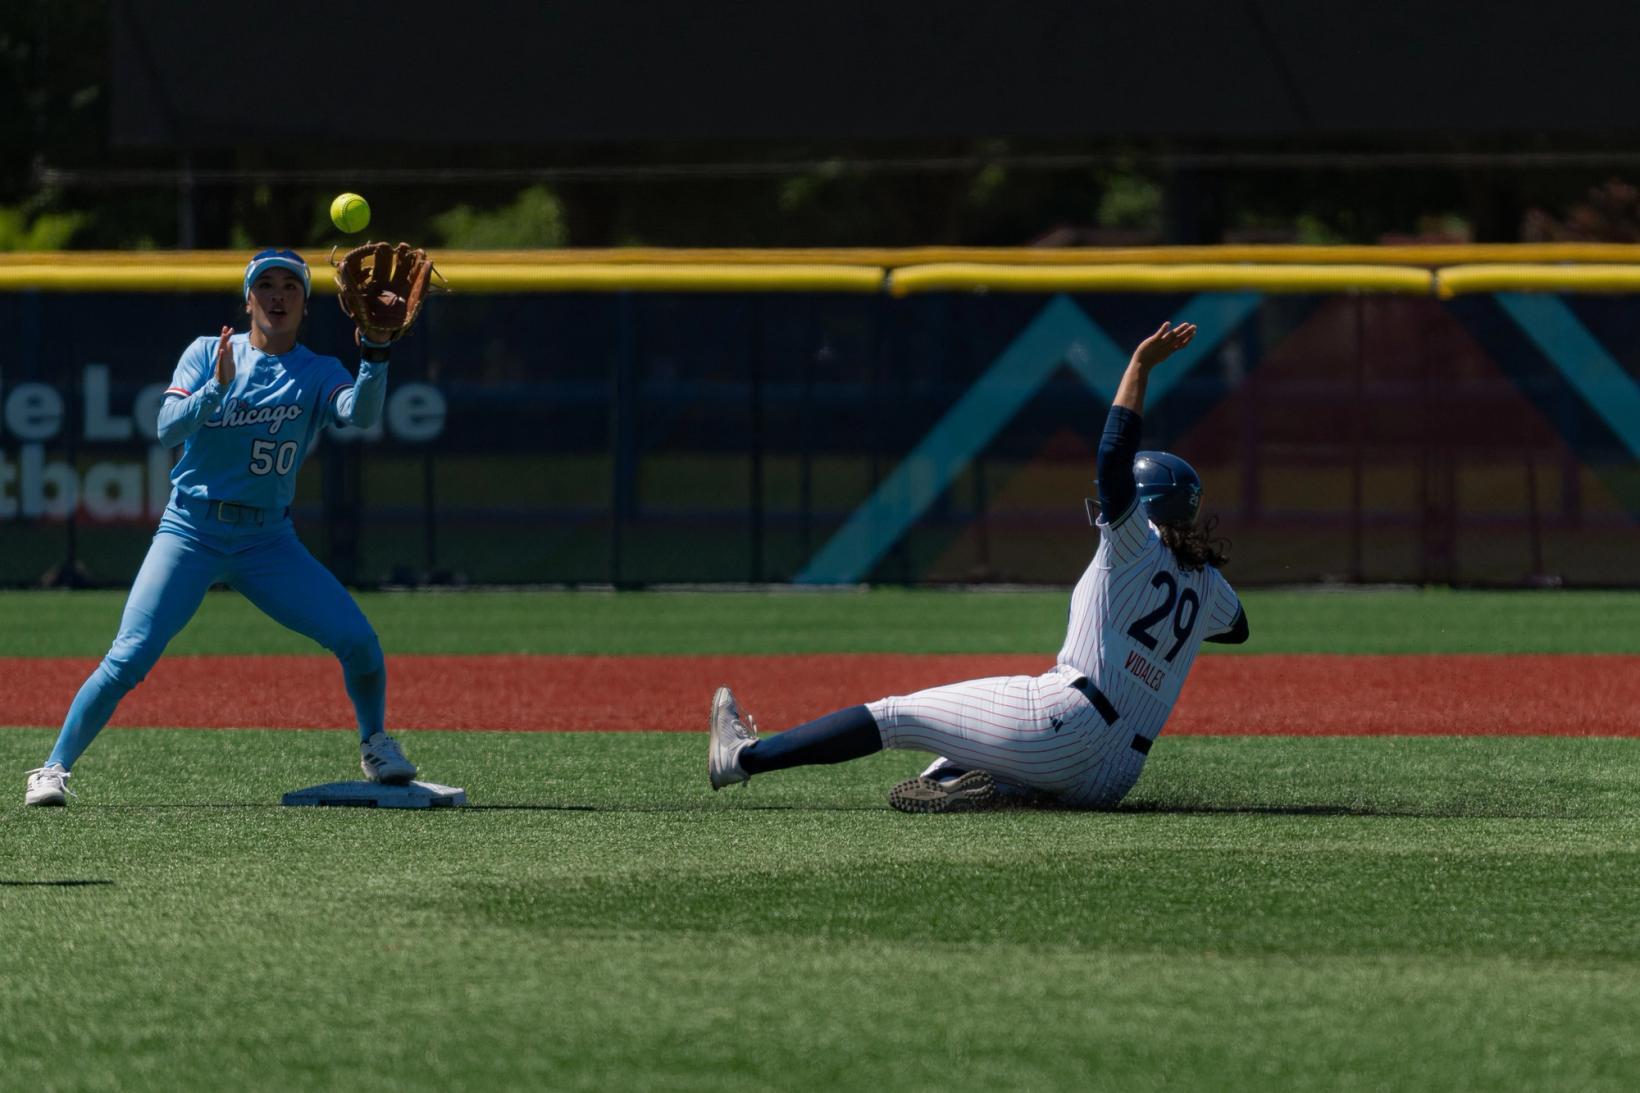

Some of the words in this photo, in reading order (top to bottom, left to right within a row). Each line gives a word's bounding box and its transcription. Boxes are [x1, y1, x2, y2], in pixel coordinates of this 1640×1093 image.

[249, 439, 298, 476] 50
[1127, 570, 1200, 663] 29
[1124, 650, 1165, 692] VIDALES
